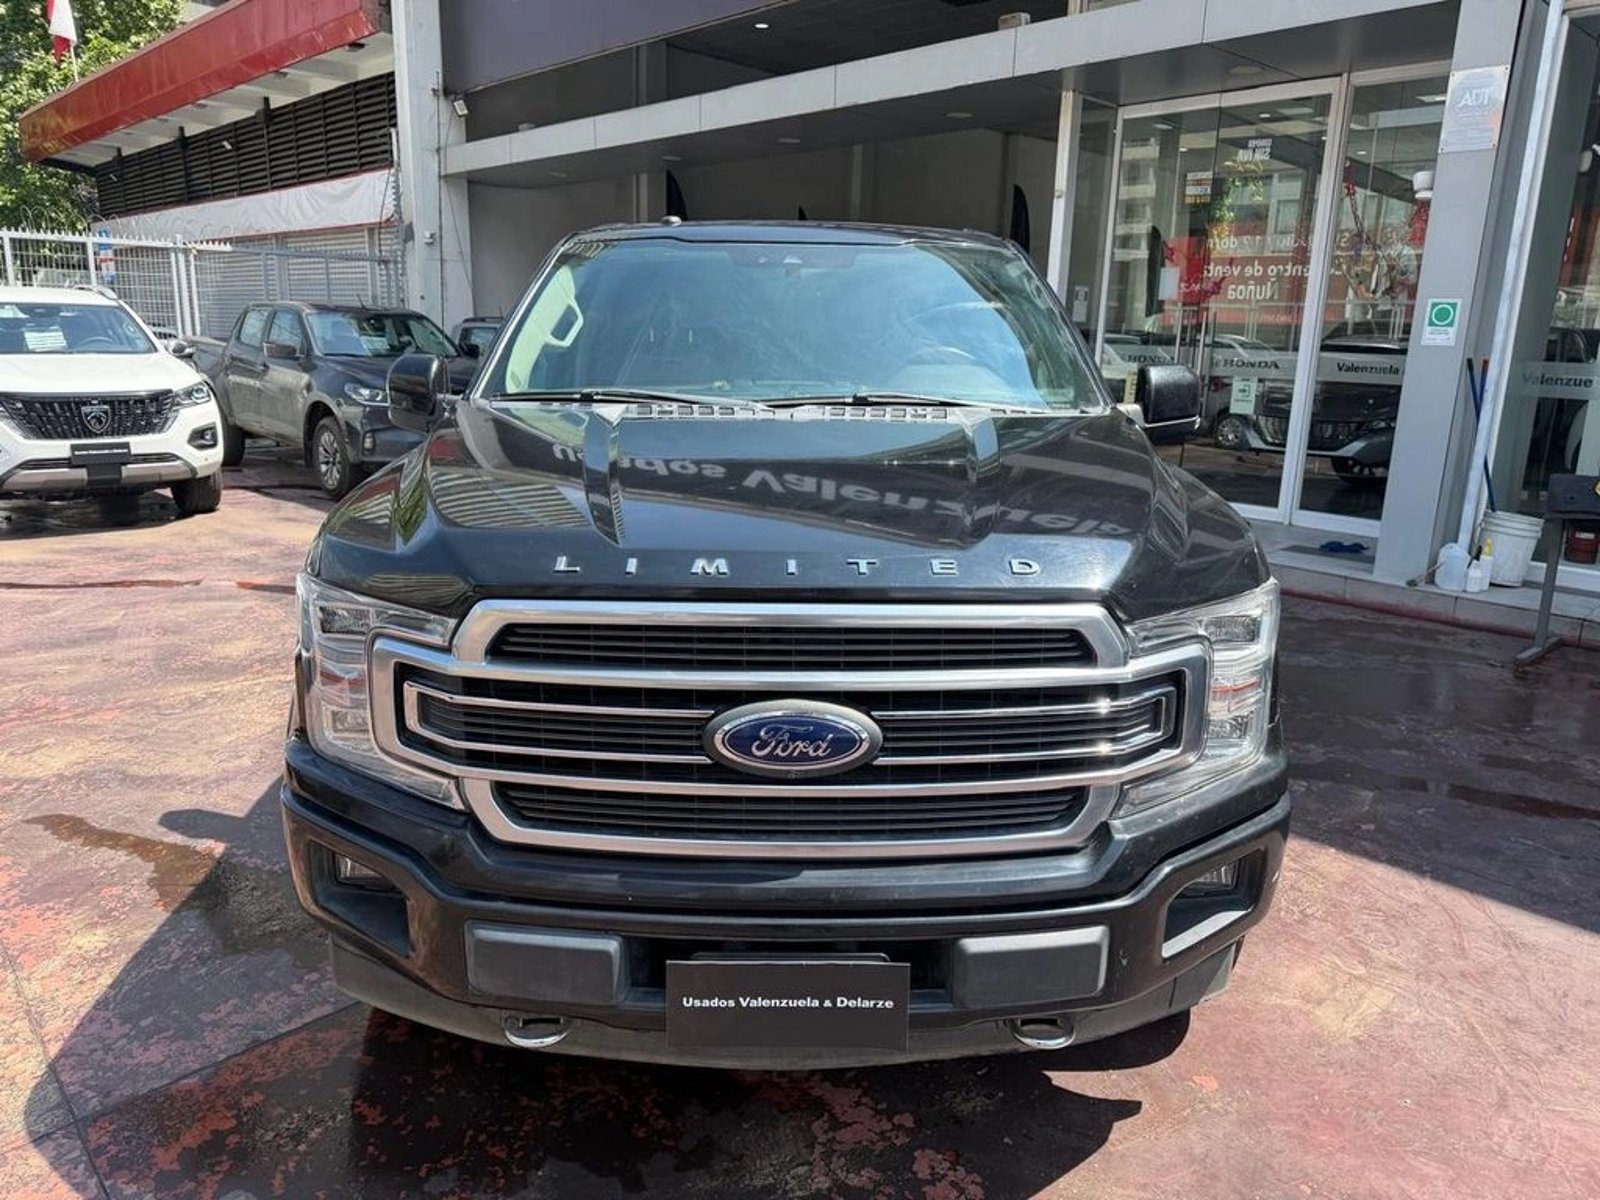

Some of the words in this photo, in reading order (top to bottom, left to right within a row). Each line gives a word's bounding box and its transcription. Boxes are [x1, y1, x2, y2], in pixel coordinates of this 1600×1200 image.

[1223, 358, 1280, 370] HONDA
[1336, 361, 1400, 377] Valenzuela
[1521, 371, 1594, 389] Valenzue
[554, 555, 1042, 577] LIMITED
[751, 724, 834, 757] Ford
[682, 996, 735, 1008] Usados
[739, 996, 820, 1008] Valenzuela
[823, 999, 832, 1008] &
[836, 996, 895, 1009] Delarze
